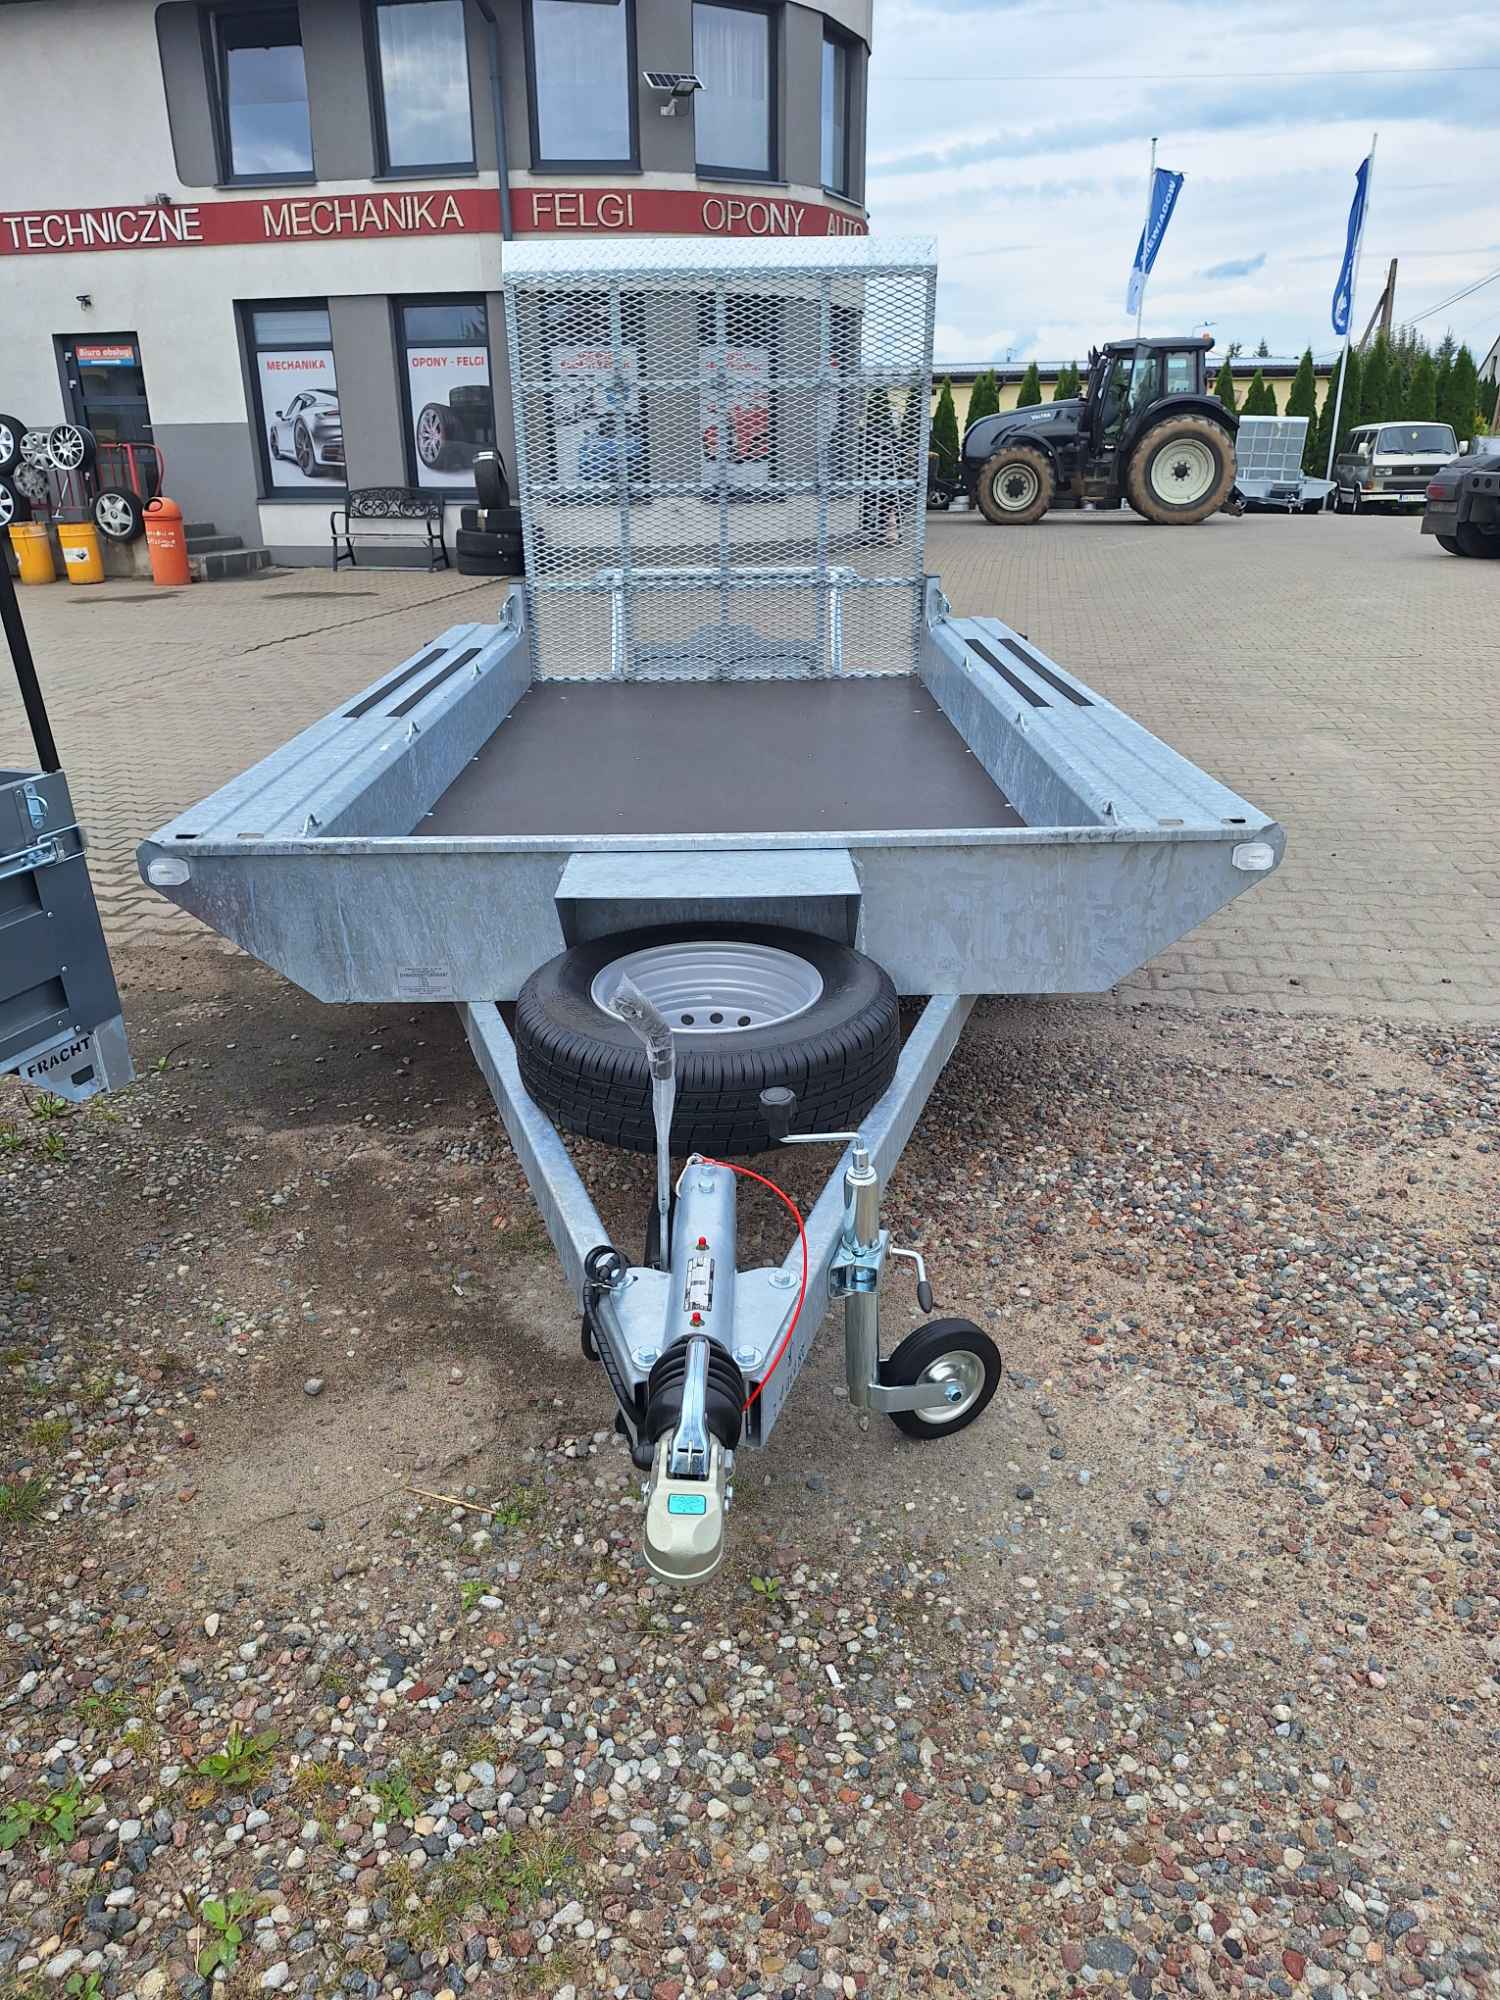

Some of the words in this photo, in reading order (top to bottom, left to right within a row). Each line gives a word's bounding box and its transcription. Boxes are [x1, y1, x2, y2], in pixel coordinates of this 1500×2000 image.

[3, 208, 203, 249] TECHNICZNE
[262, 194, 465, 238] MECHANIKA
[531, 193, 634, 228] FELGI
[702, 199, 805, 236] OPONY
[266, 360, 326, 371] MECHANIKA
[412, 357, 447, 368] OPONY
[457, 356, 485, 367] FELGI
[27, 1036, 90, 1078] FRACHT
